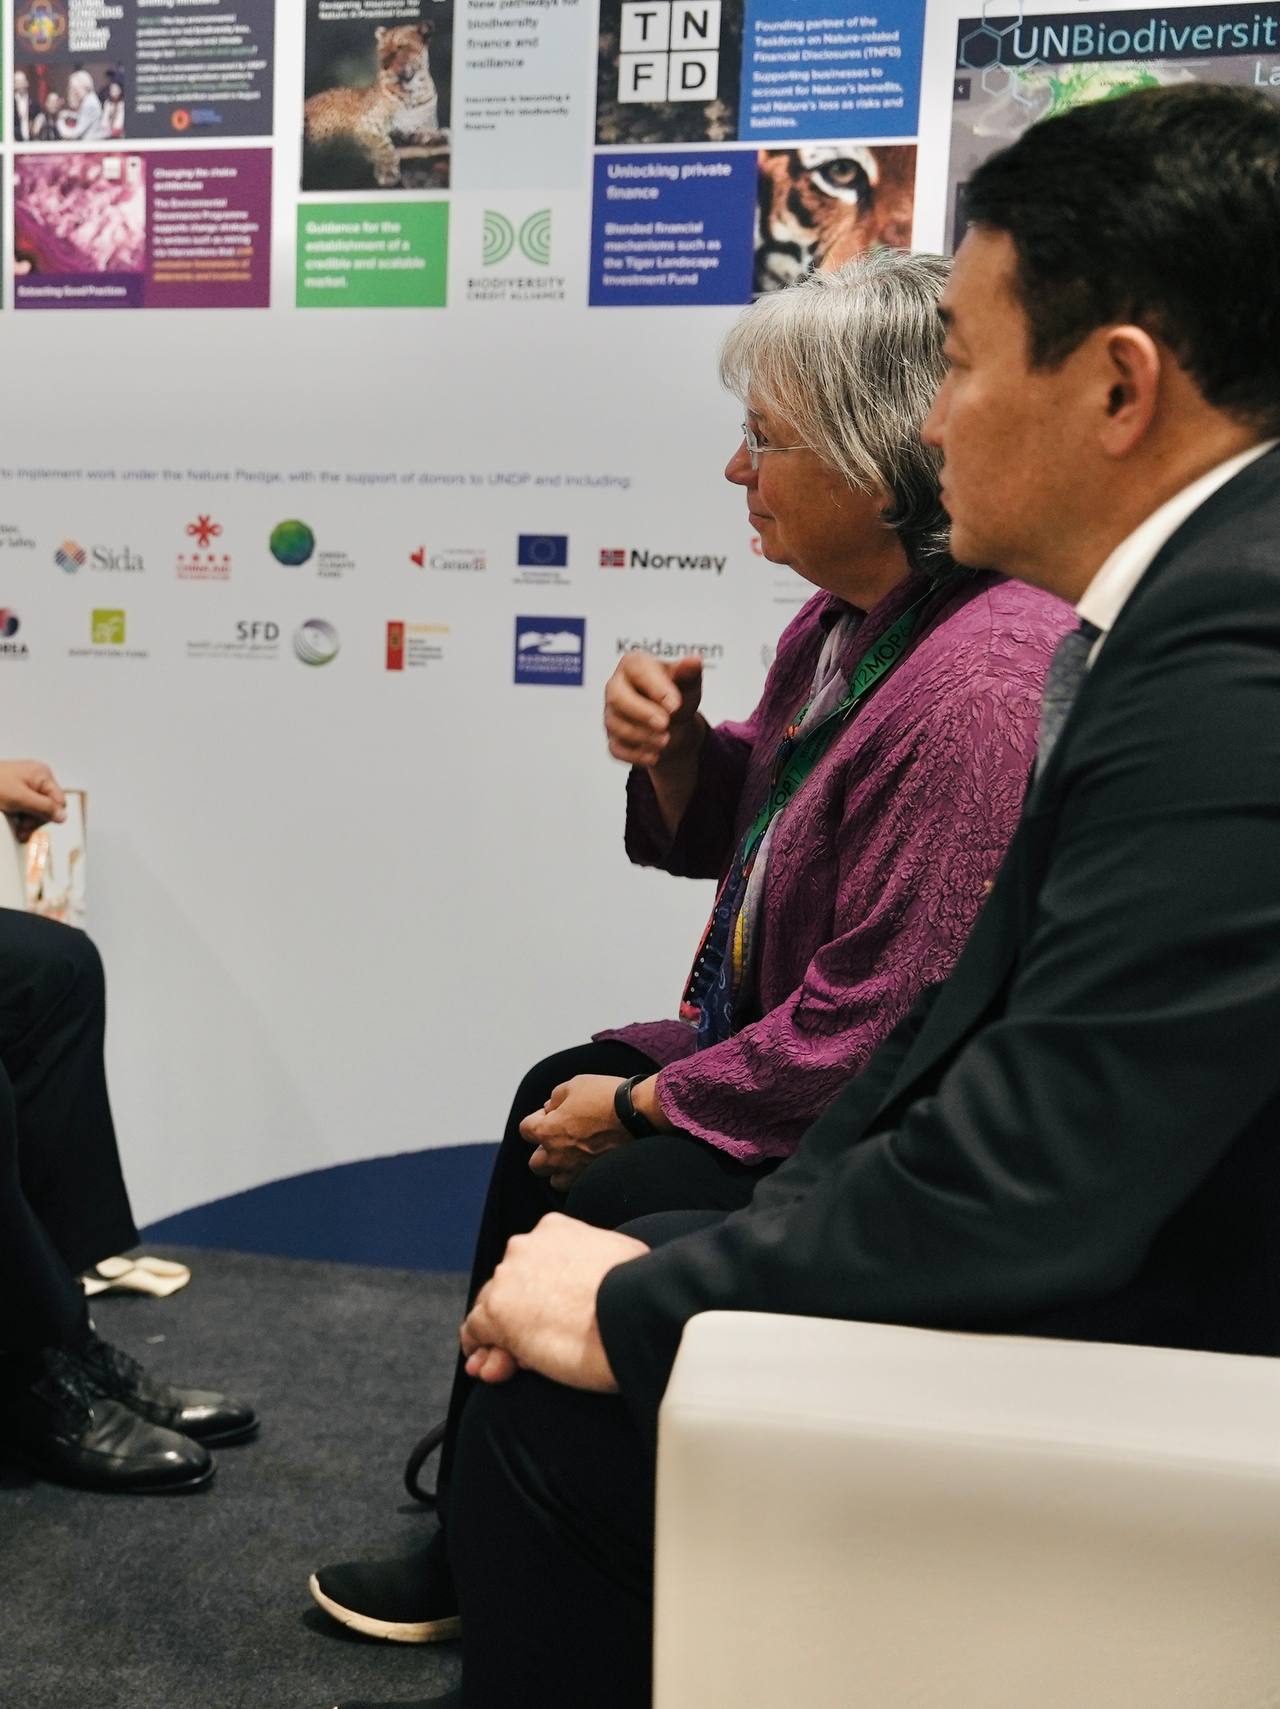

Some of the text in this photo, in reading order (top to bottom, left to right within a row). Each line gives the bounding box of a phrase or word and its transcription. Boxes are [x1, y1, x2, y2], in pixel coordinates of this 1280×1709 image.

[467, 17, 538, 31] biodiversity
[755, 17, 877, 33] Founding partner of the
[466, 37, 538, 49] finance and
[756, 34, 804, 47] Taskforce
[808, 36, 822, 46] on
[1012, 14, 1280, 59] UNBiodiversit
[754, 46, 901, 63] Financial Disclosures (TNFD)
[753, 67, 883, 84] Supporting businesses to
[751, 87, 793, 98] account
[795, 85, 809, 97] for
[812, 83, 856, 95] Nature's
[751, 96, 903, 113] and Nature's loss as risks and
[750, 115, 799, 129] liabilities.
[607, 162, 732, 181] Unlocking private
[607, 185, 659, 200] finance
[305, 221, 401, 234] Guidance for the
[605, 221, 704, 236] Blended financial
[305, 240, 385, 252] establishment
[387, 239, 400, 251] of
[604, 238, 721, 252] mechanisms such as
[305, 256, 426, 270] credible and scalable
[603, 255, 719, 272] the Tiger Landscape
[467, 277, 566, 289] BIODIVERSITY
[603, 273, 698, 286] Investment Fund
[467, 291, 566, 301] CREDIT ALLIANCE
[2, 468, 14, 479] to
[17, 468, 84, 482] implement
[87, 469, 117, 481] work
[122, 469, 159, 481] under
[163, 469, 182, 481] the
[187, 470, 231, 482] Nature
[235, 470, 281, 484] Pledge,
[289, 471, 316, 482] with
[321, 471, 342, 483] the
[346, 472, 399, 487] support
[402, 472, 415, 484] of
[419, 473, 468, 486] donors
[471, 474, 485, 486] to
[488, 474, 530, 487] UNDP
[535, 475, 562, 487] and
[90, 545, 145, 573] Sida
[630, 550, 727, 575] Norway
[235, 621, 280, 641] SFD
